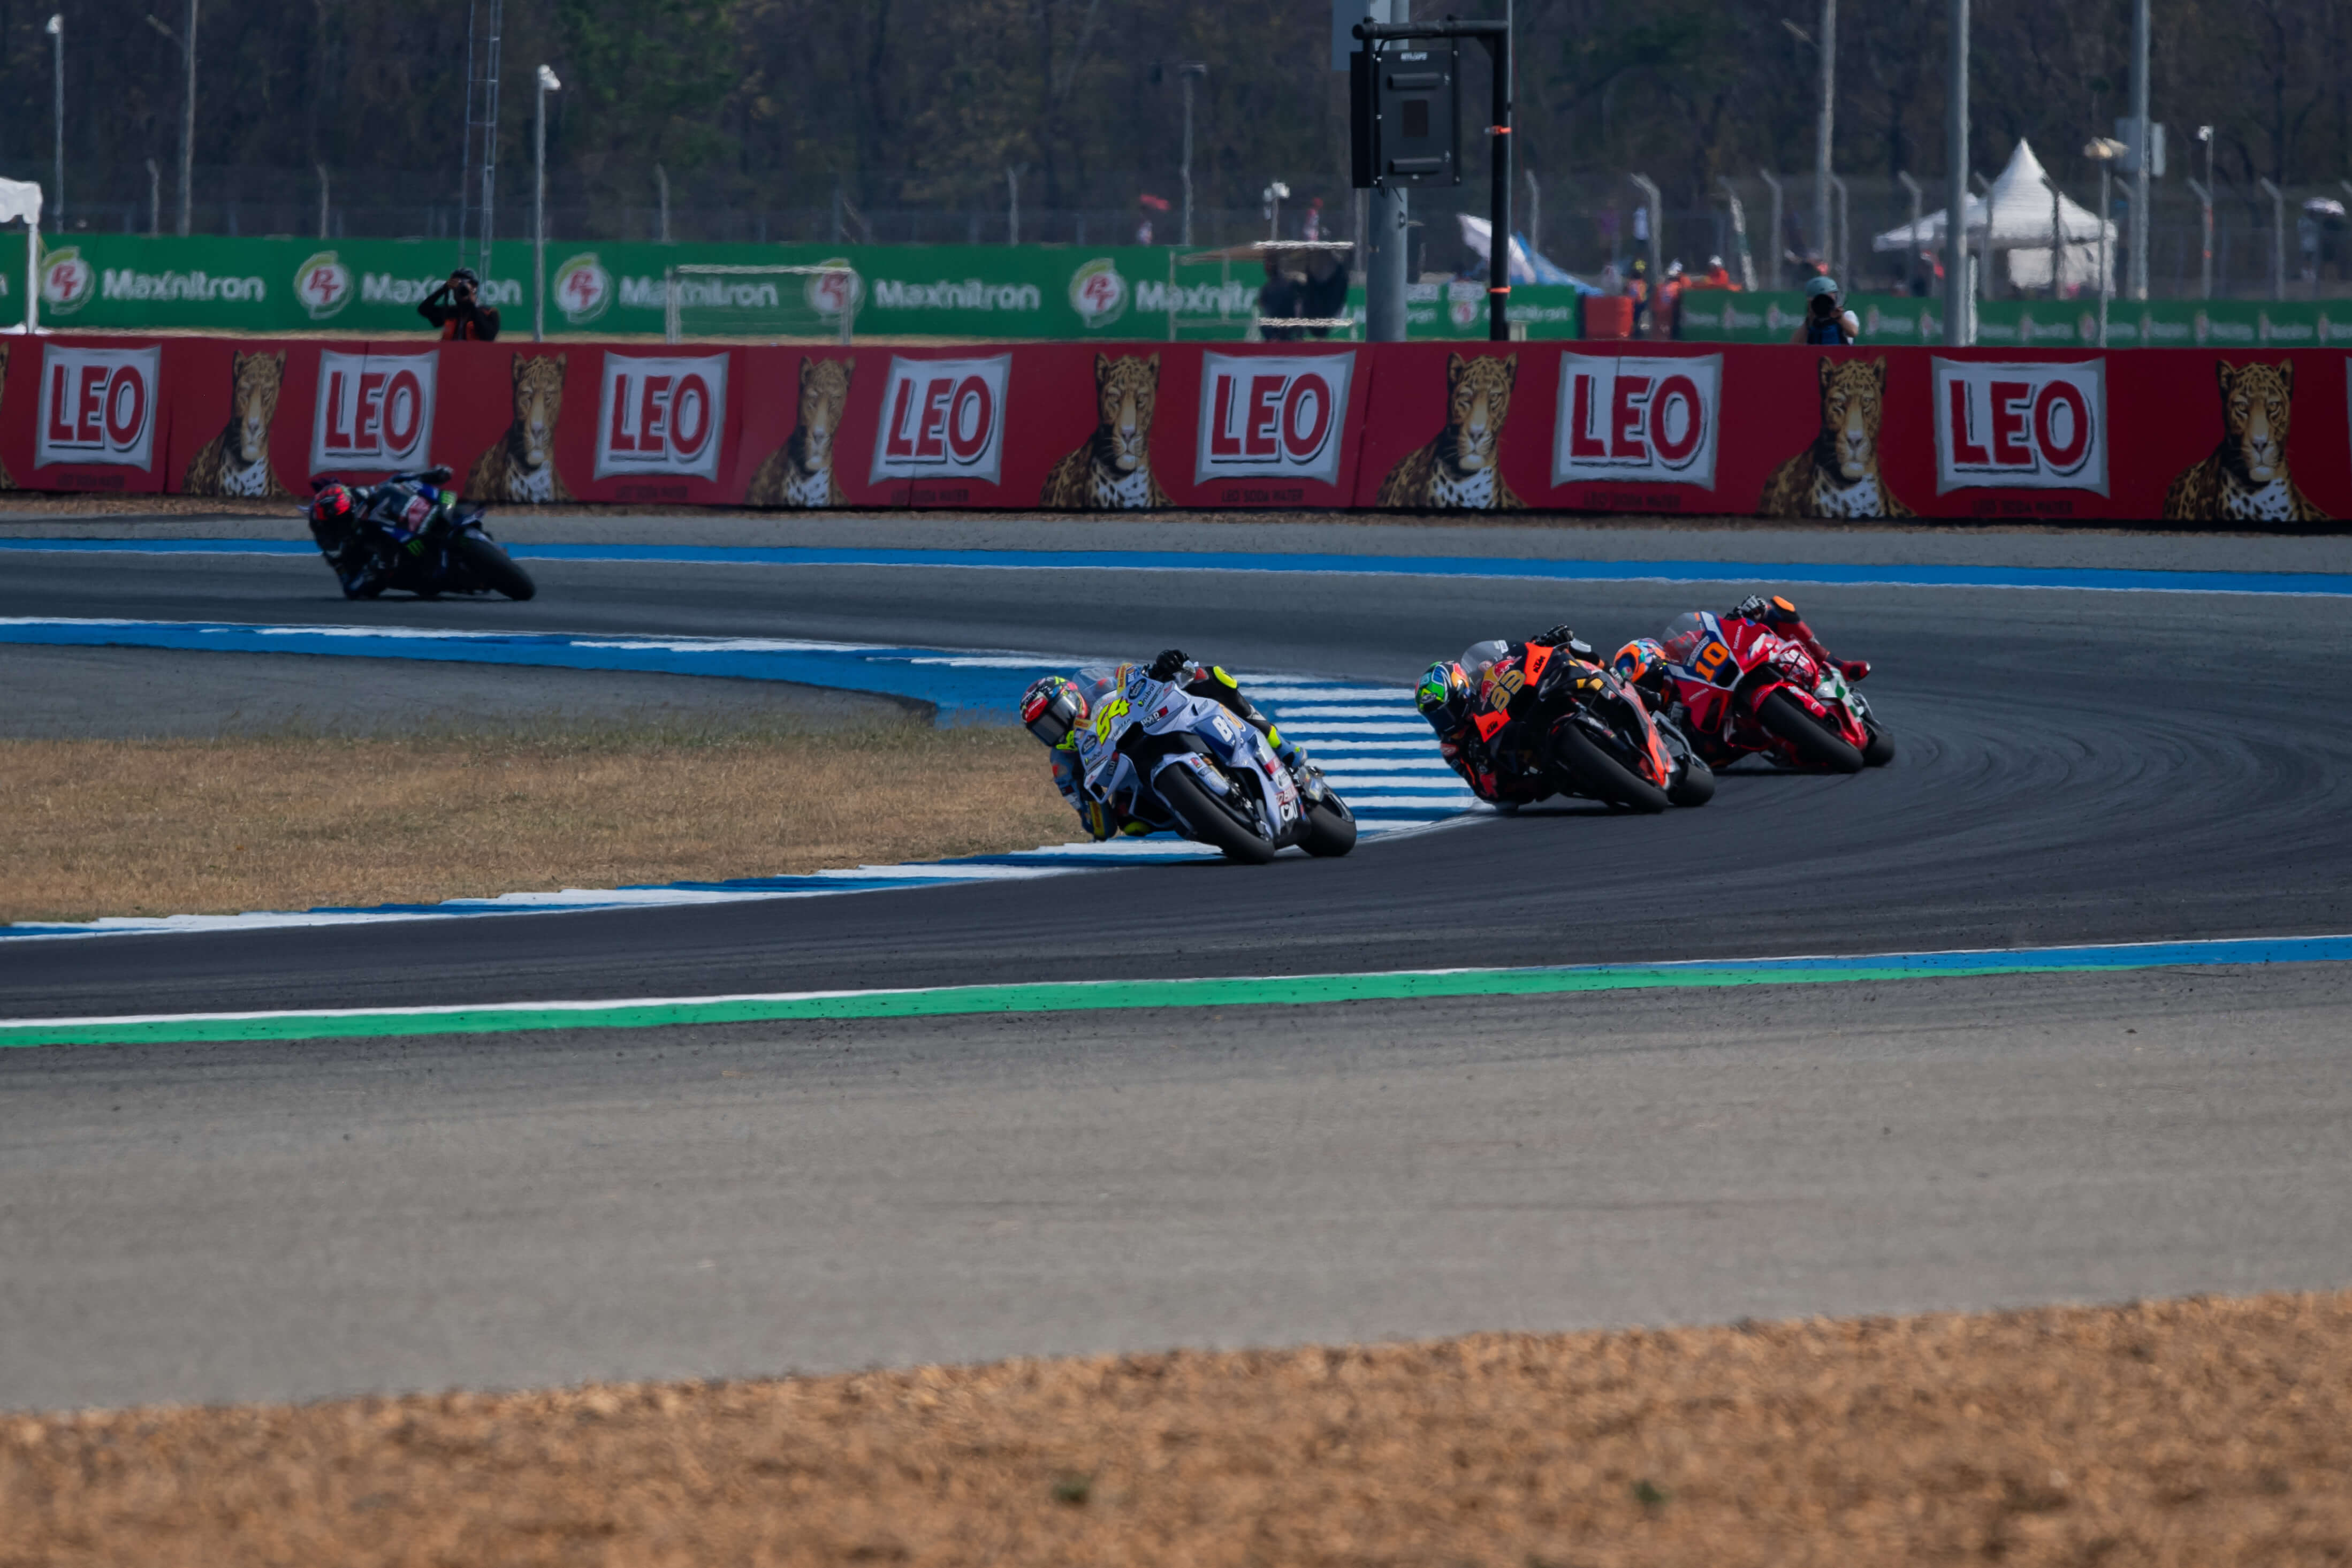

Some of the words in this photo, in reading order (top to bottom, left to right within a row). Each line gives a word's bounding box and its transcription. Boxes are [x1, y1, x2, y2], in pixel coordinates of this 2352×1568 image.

[361, 272, 522, 306] Maxon
[49, 365, 144, 444] LEO
[325, 369, 422, 450] LEO
[611, 373, 710, 454] LEO
[886, 375, 992, 458] LEO
[1212, 372, 1330, 456] LEO
[1571, 374, 1701, 460] LEO
[1950, 379, 2087, 466] LEO
[1490, 669, 1526, 714] 33
[1695, 642, 1729, 682] 10
[1096, 696, 1132, 745] 54
